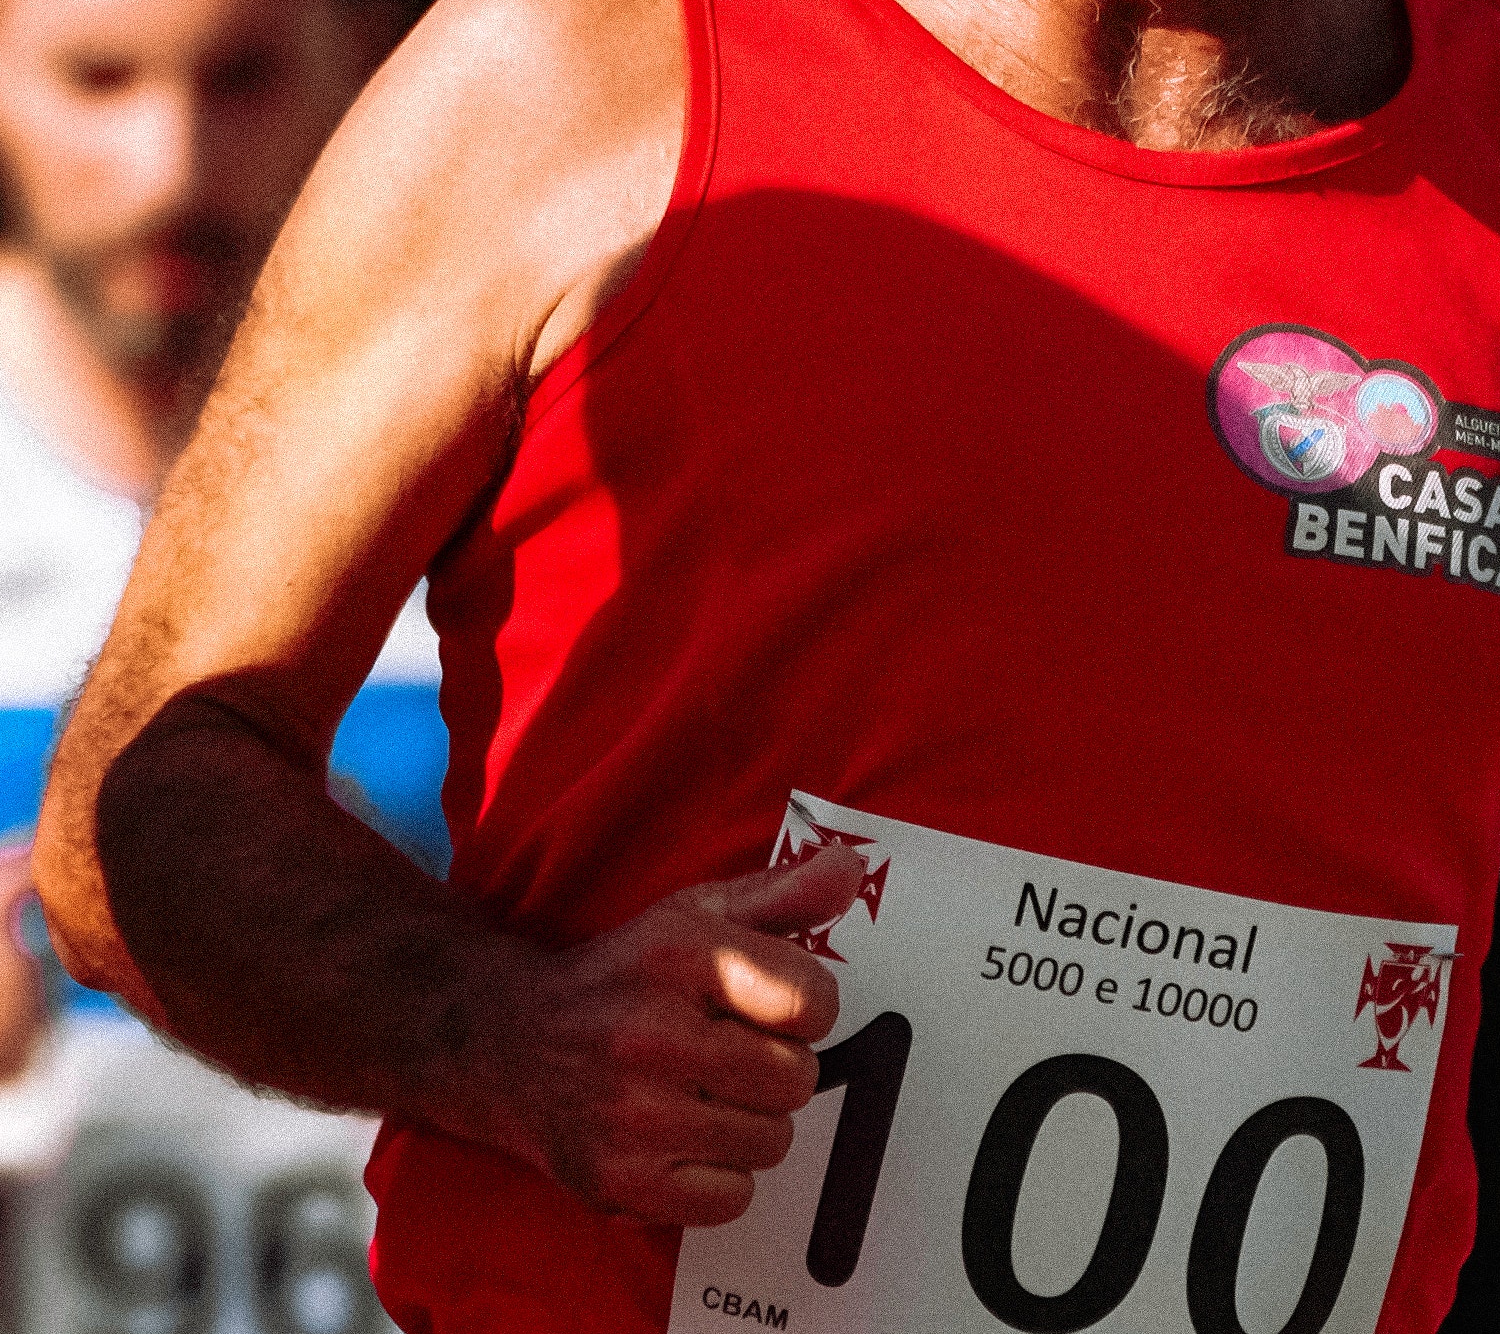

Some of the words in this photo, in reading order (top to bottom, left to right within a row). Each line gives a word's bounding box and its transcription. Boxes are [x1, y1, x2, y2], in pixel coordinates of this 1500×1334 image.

[1013, 881, 1259, 973] Nacional
[980, 944, 1086, 997] 5000
[1094, 977, 1119, 1005] e
[1132, 977, 1260, 1034] 10000
[701, 1285, 791, 1332] CBAM
